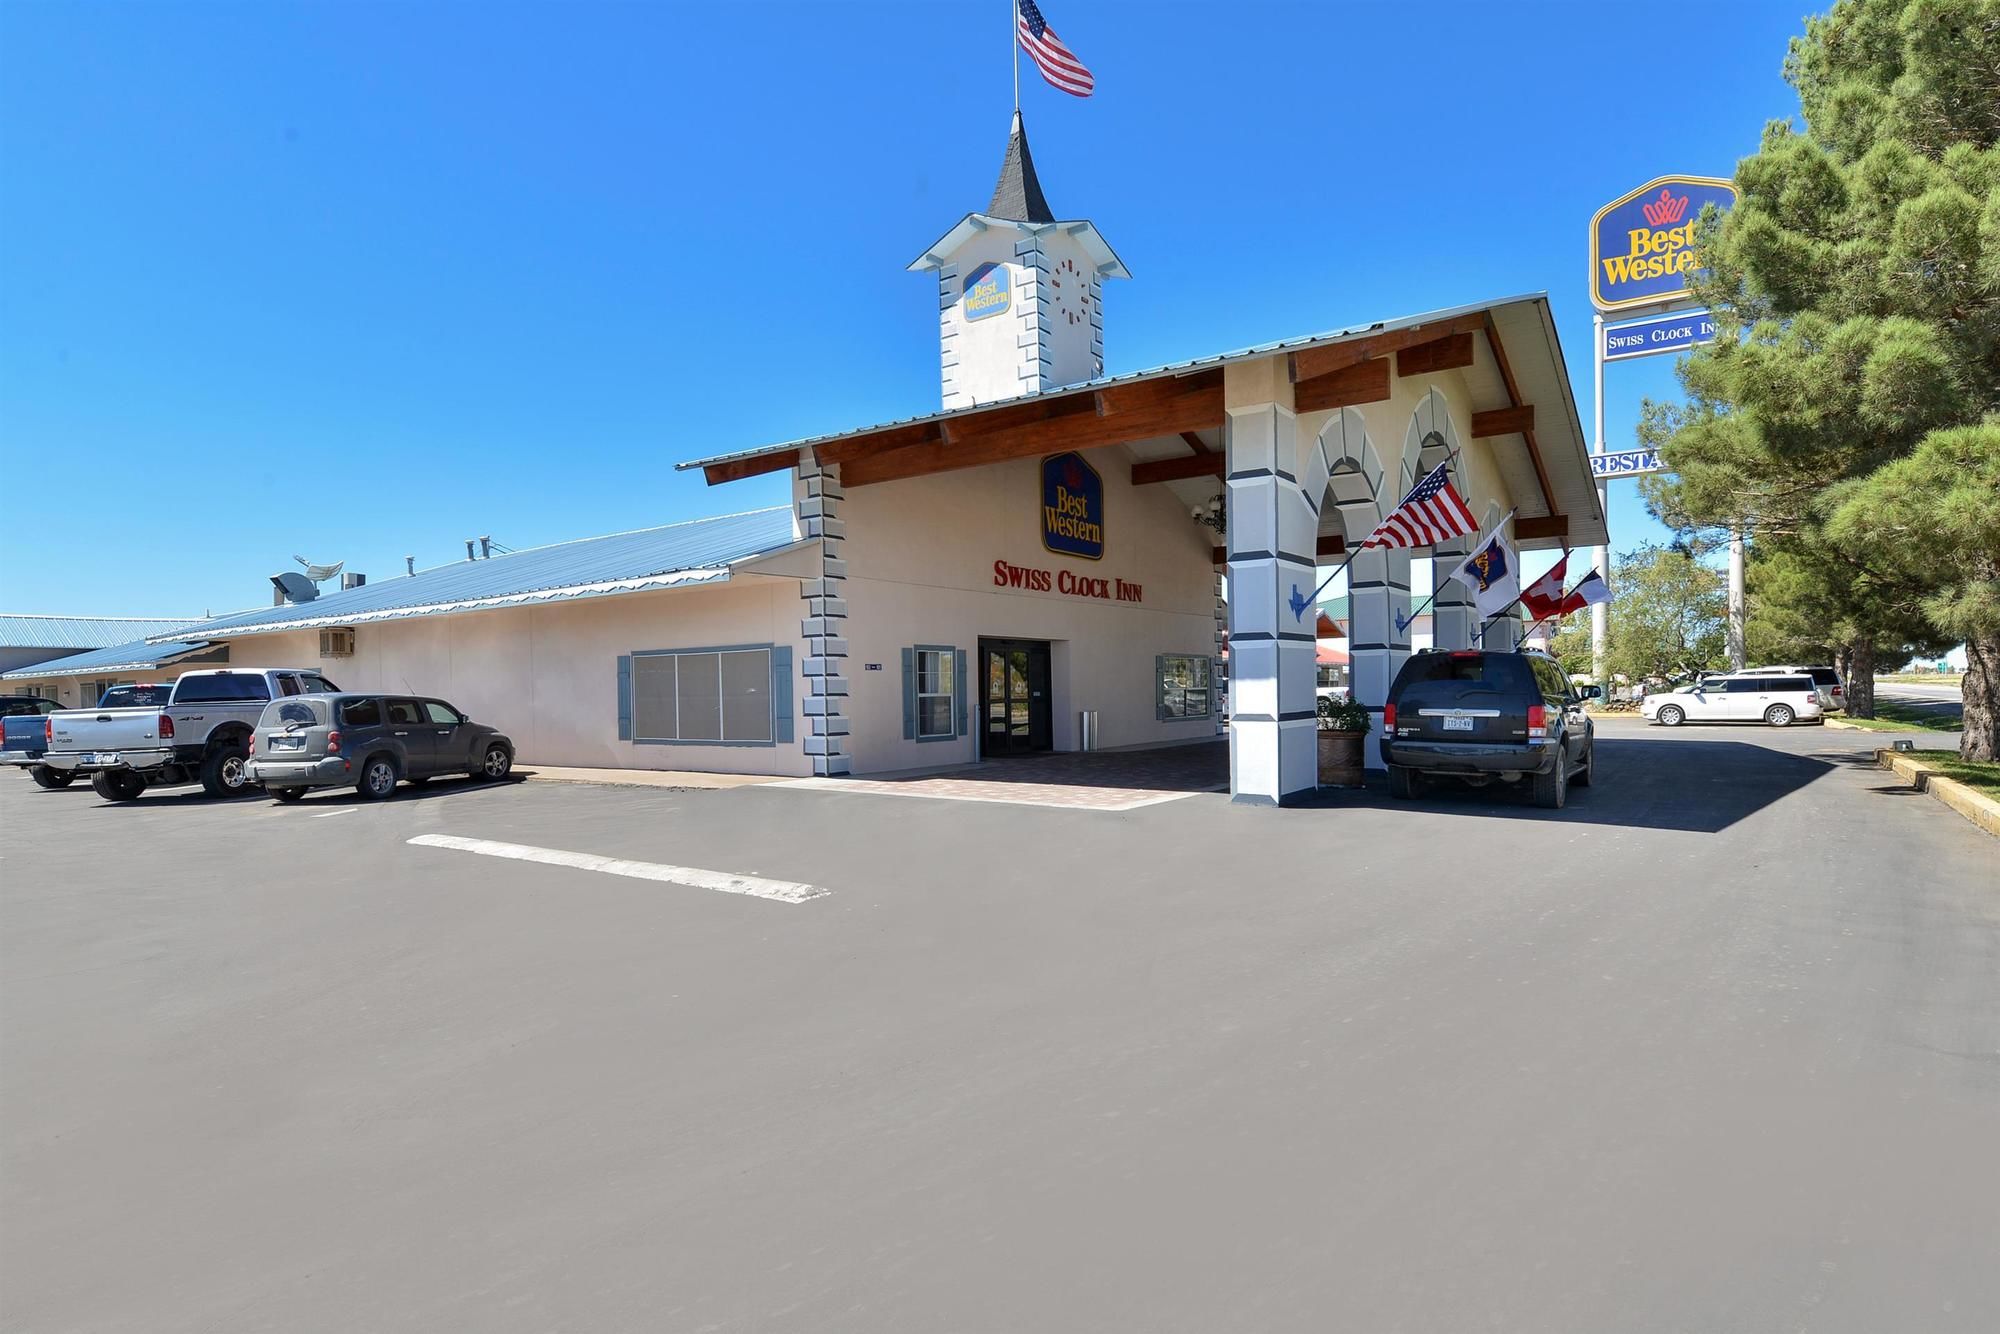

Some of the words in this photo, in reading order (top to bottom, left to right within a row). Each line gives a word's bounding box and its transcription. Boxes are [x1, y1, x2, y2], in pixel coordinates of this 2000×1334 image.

[1628, 218, 1695, 258] Best
[1602, 246, 1705, 285] Weste
[967, 292, 1008, 310] Western
[975, 281, 997, 300] Best
[1608, 334, 1645, 350] SWISS
[1651, 325, 1693, 343] CLOCK
[1589, 451, 1669, 474] RESTA
[1057, 485, 1088, 518] Best
[1044, 505, 1101, 544] Western
[994, 560, 1051, 592] SWISS
[1057, 570, 1110, 599] CLOCK
[1115, 578, 1142, 603] INN
